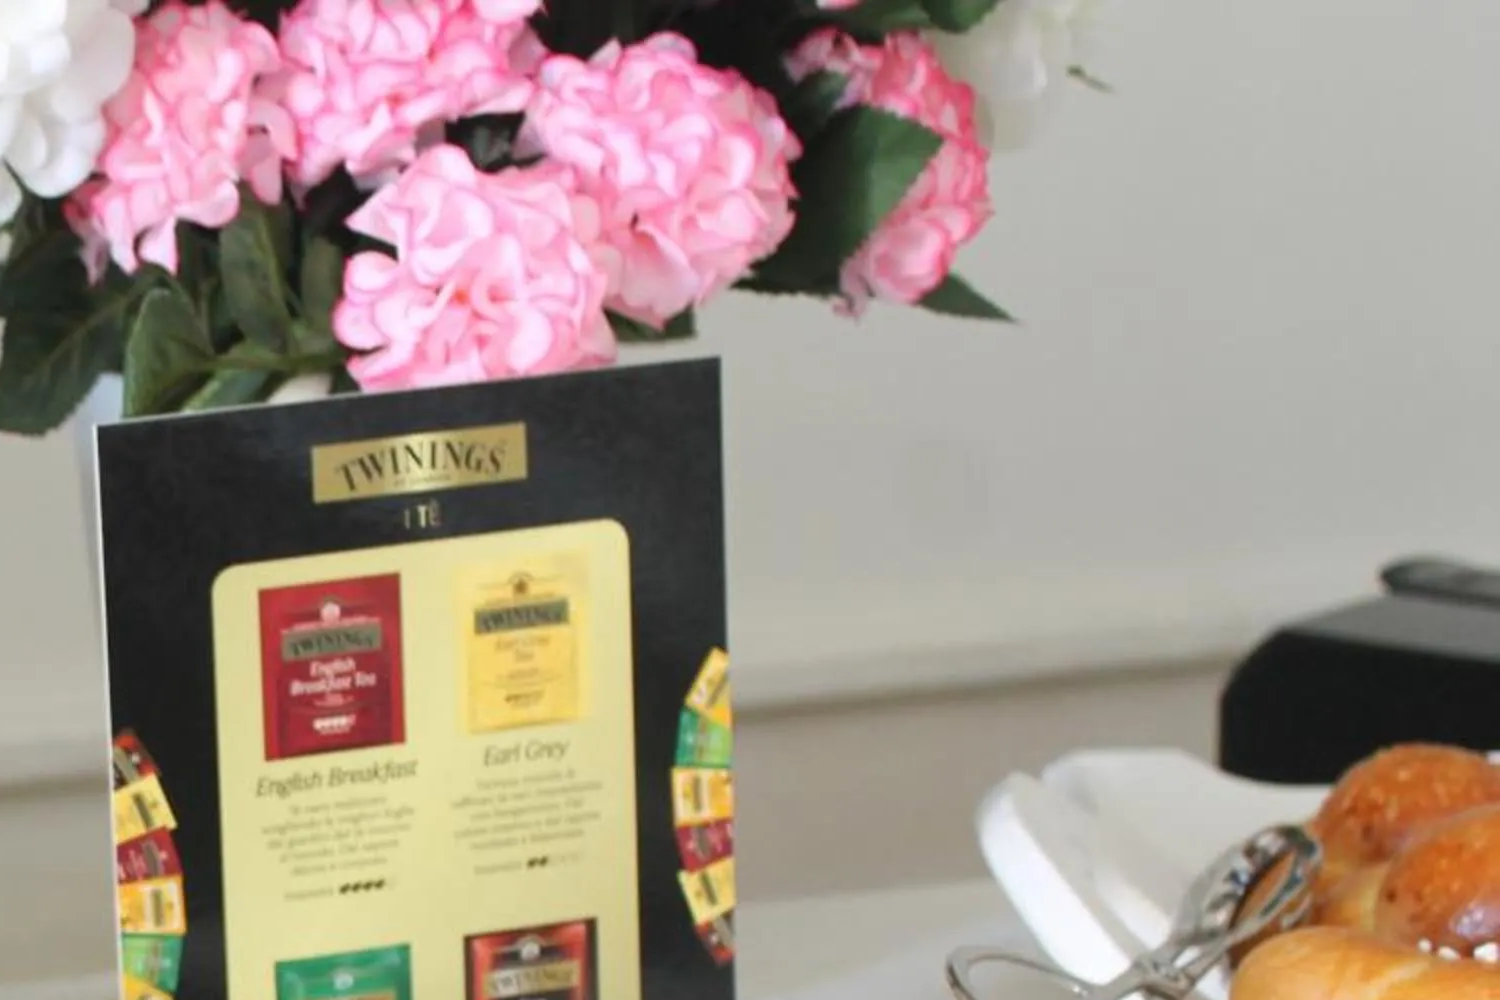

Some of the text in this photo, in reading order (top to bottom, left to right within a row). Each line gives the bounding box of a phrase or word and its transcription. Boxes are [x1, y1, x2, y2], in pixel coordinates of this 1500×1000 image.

[335, 440, 506, 492] TWININGS
[484, 743, 520, 767] Earl
[256, 760, 418, 798] English Breakfast
